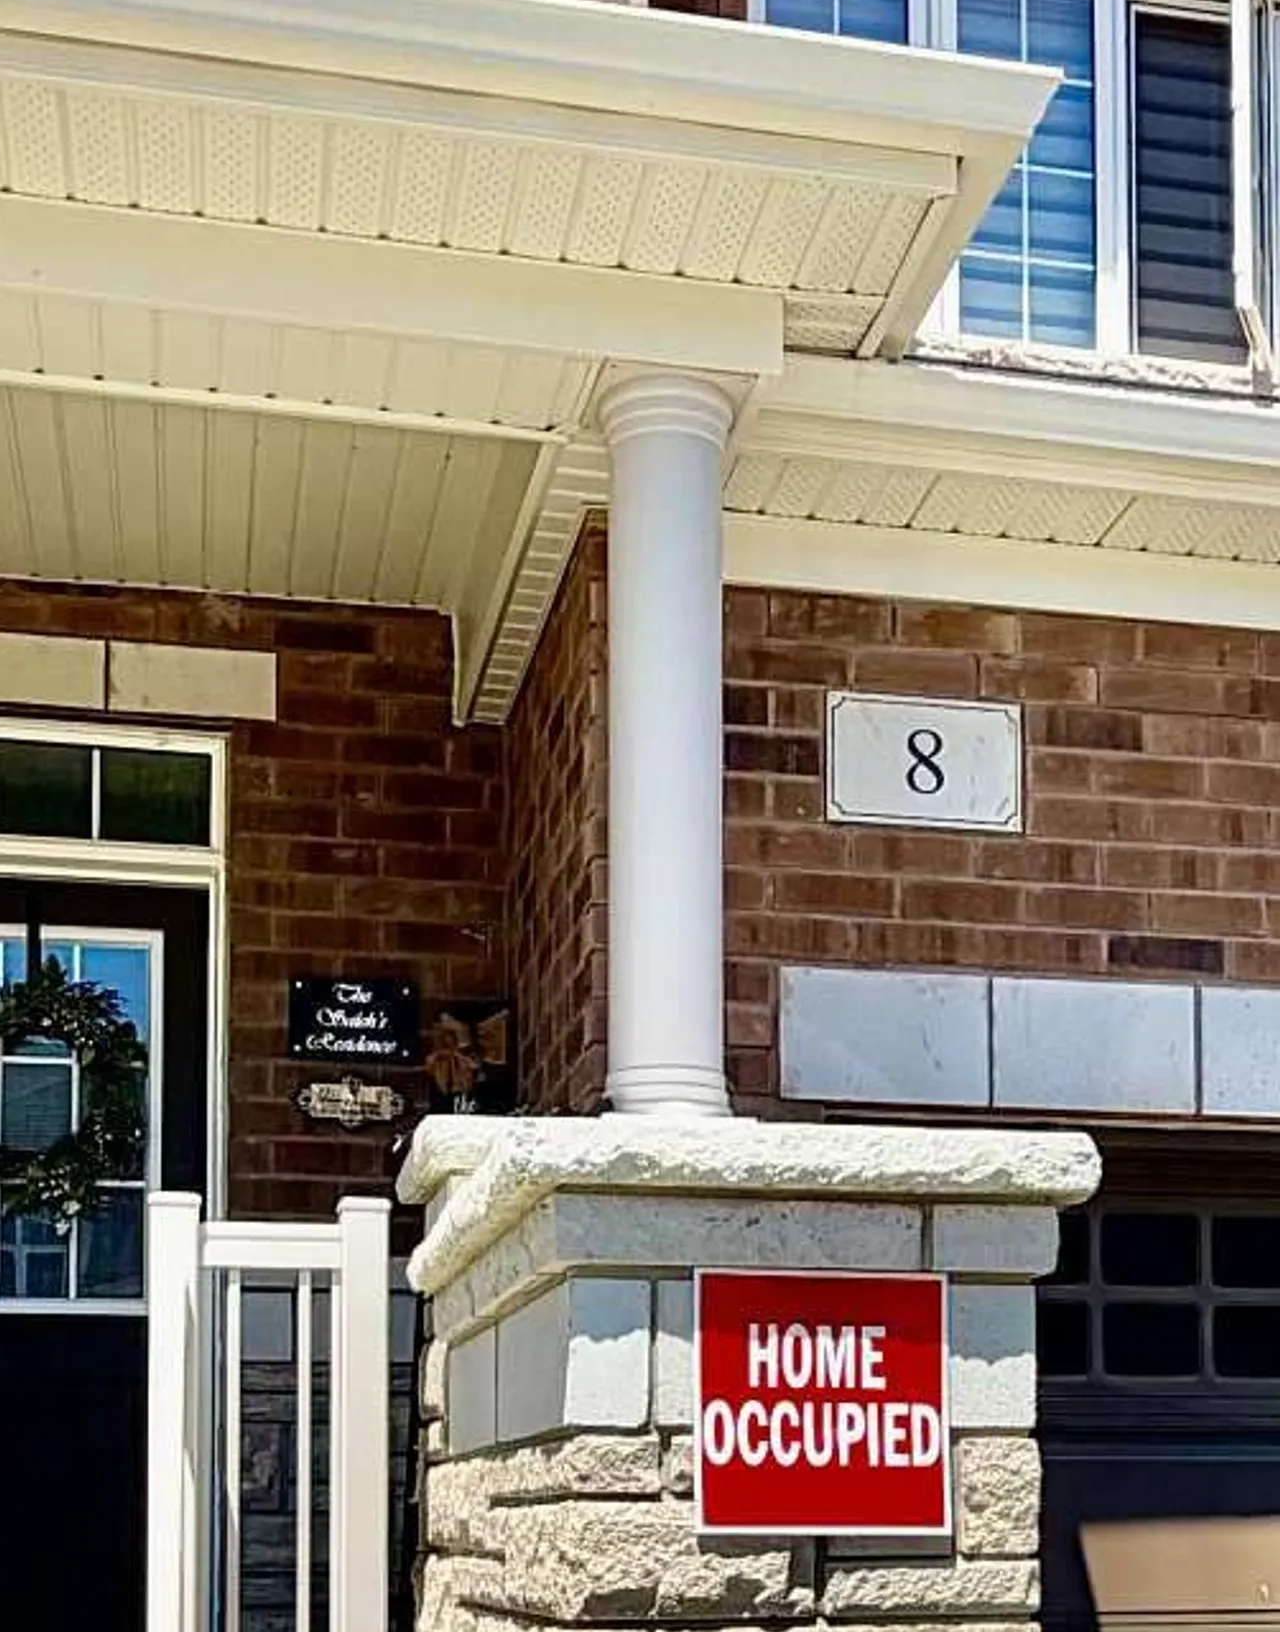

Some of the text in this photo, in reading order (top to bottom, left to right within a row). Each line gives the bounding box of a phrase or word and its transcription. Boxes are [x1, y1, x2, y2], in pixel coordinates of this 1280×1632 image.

[906, 729, 945, 794] 8
[748, 1323, 886, 1390] HOME
[702, 1399, 941, 1467] OCCUPIED
